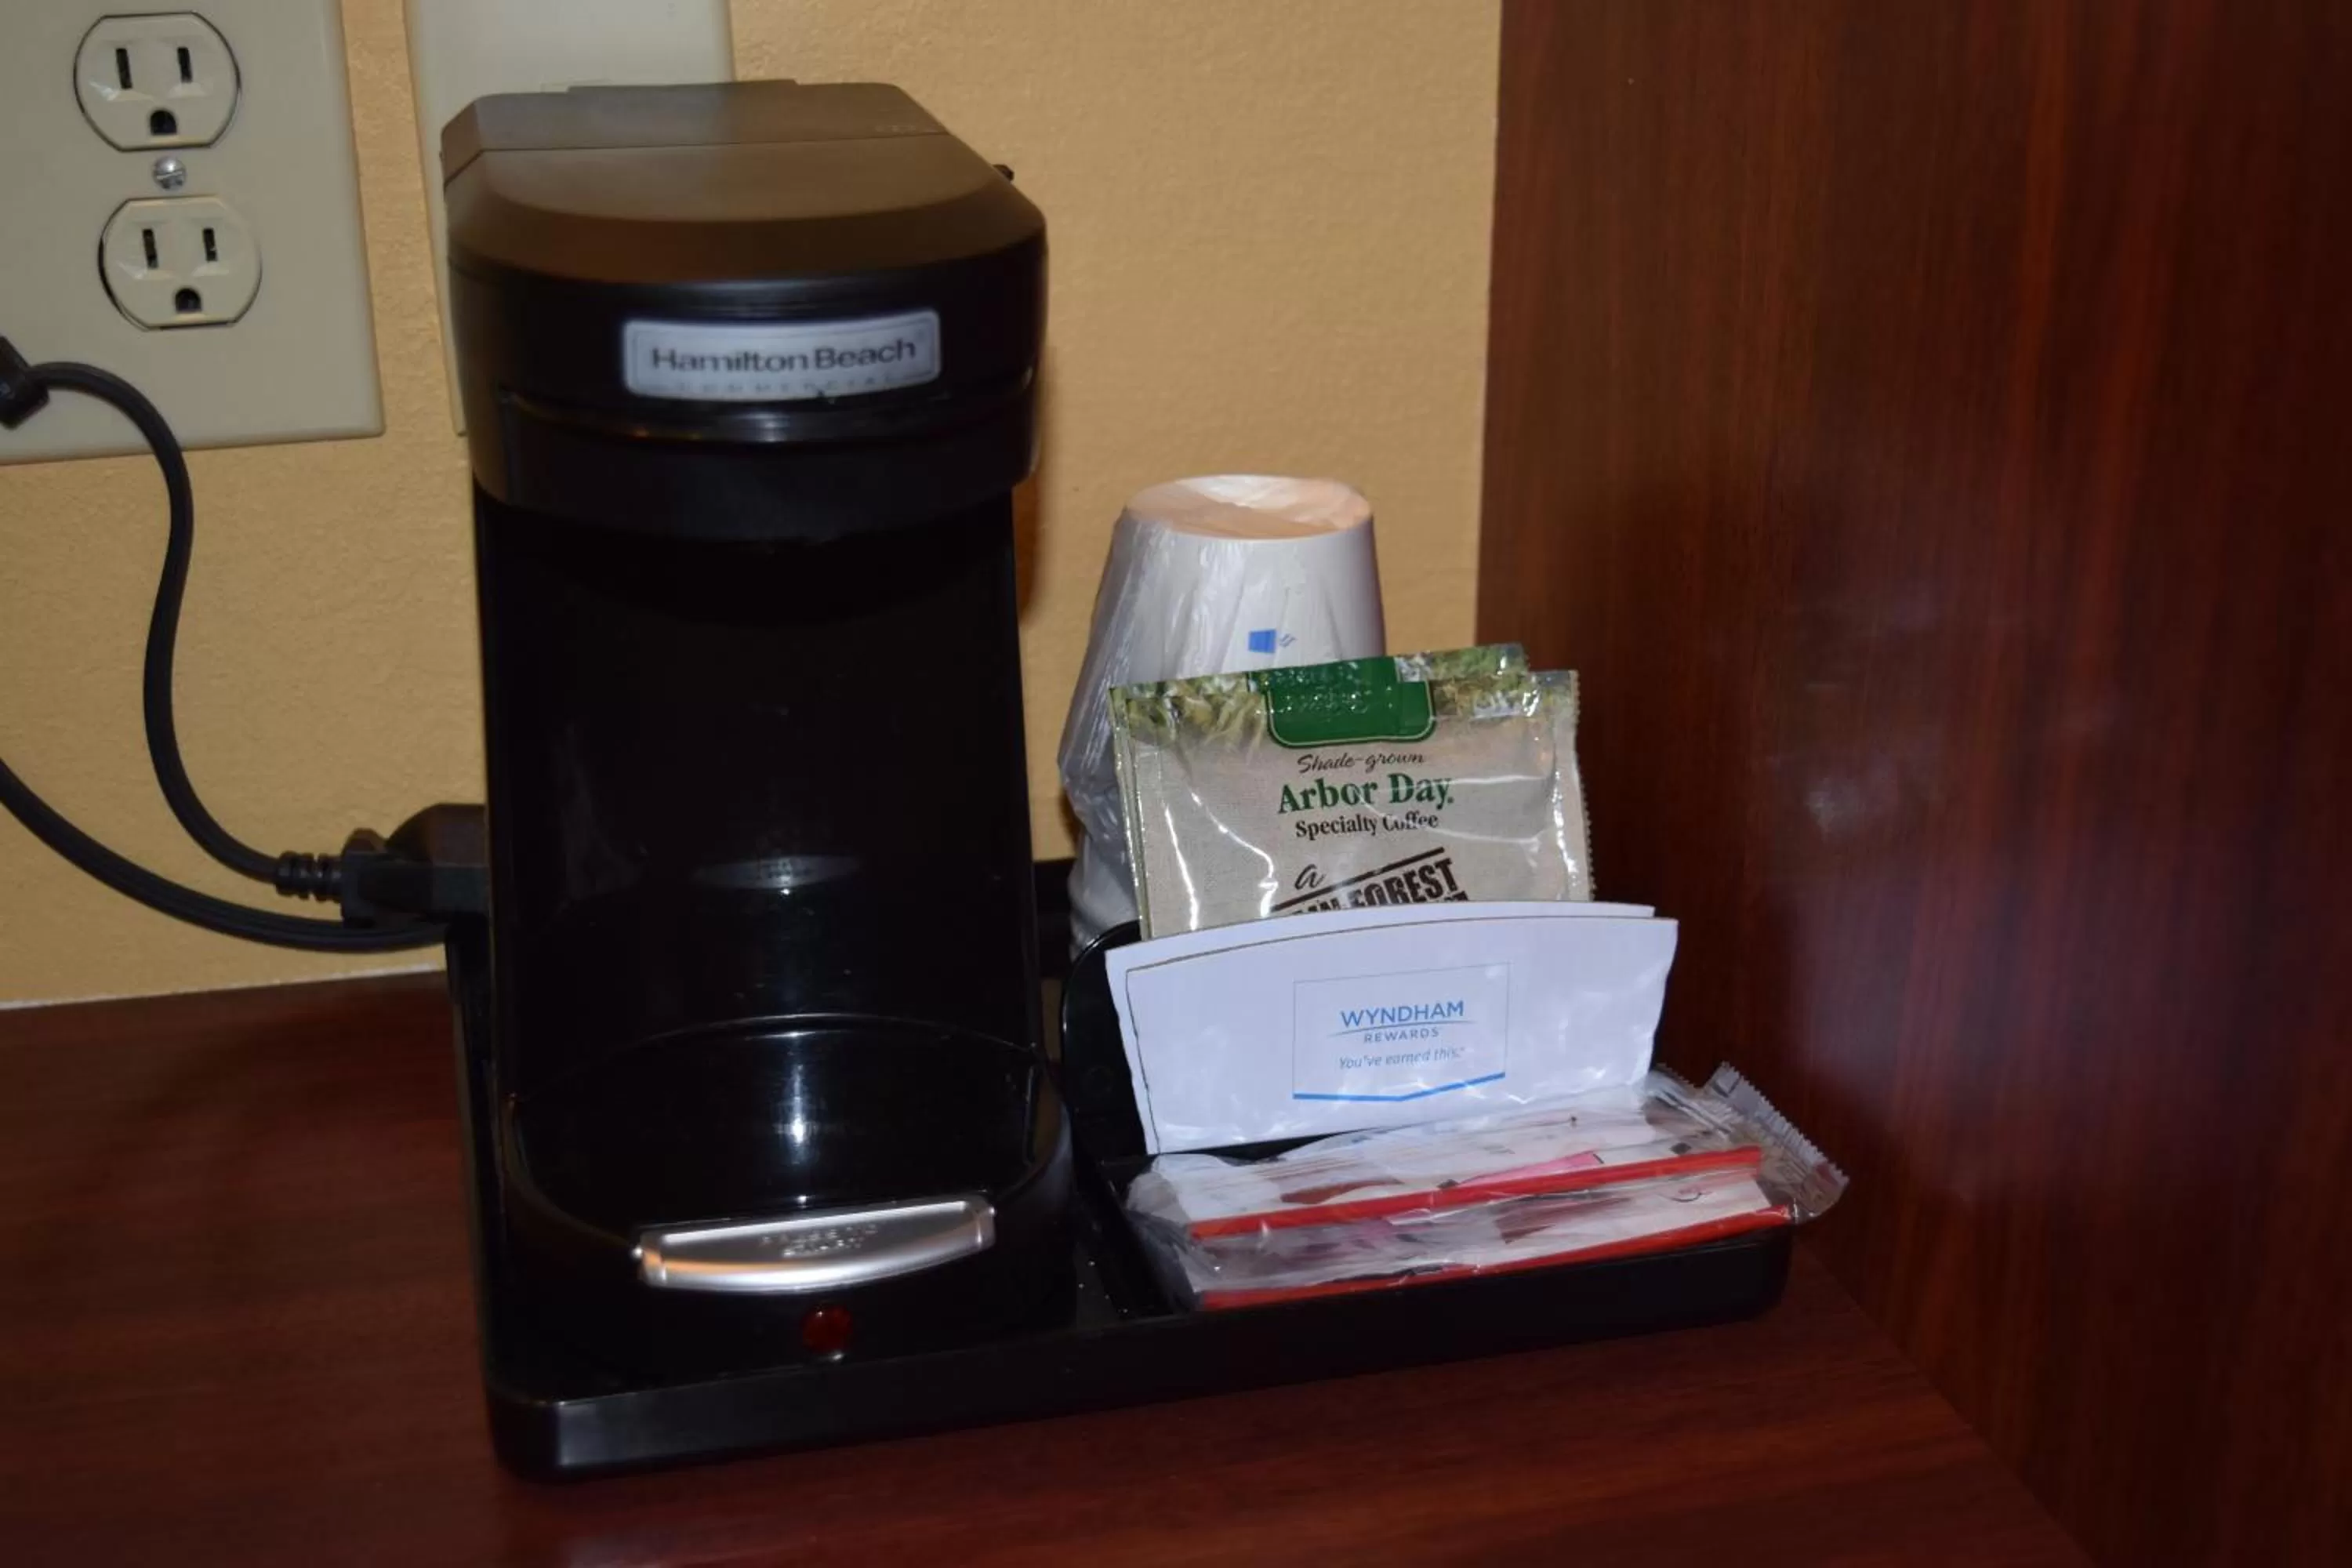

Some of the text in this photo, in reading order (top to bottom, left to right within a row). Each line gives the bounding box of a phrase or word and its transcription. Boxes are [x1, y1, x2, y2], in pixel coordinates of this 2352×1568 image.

[652, 338, 916, 372] Hamilton Beach
[1297, 752, 1426, 774] Shade-grown
[1278, 778, 1377, 814] Arbor
[1296, 810, 1439, 840] Specialty Coffee
[1294, 864, 1326, 891] a
[1340, 1000, 1465, 1028] WYNDHAM
[1363, 1027, 1439, 1044] REWARDS
[1339, 1053, 1382, 1070] You've
[1385, 1048, 1430, 1065] earned
